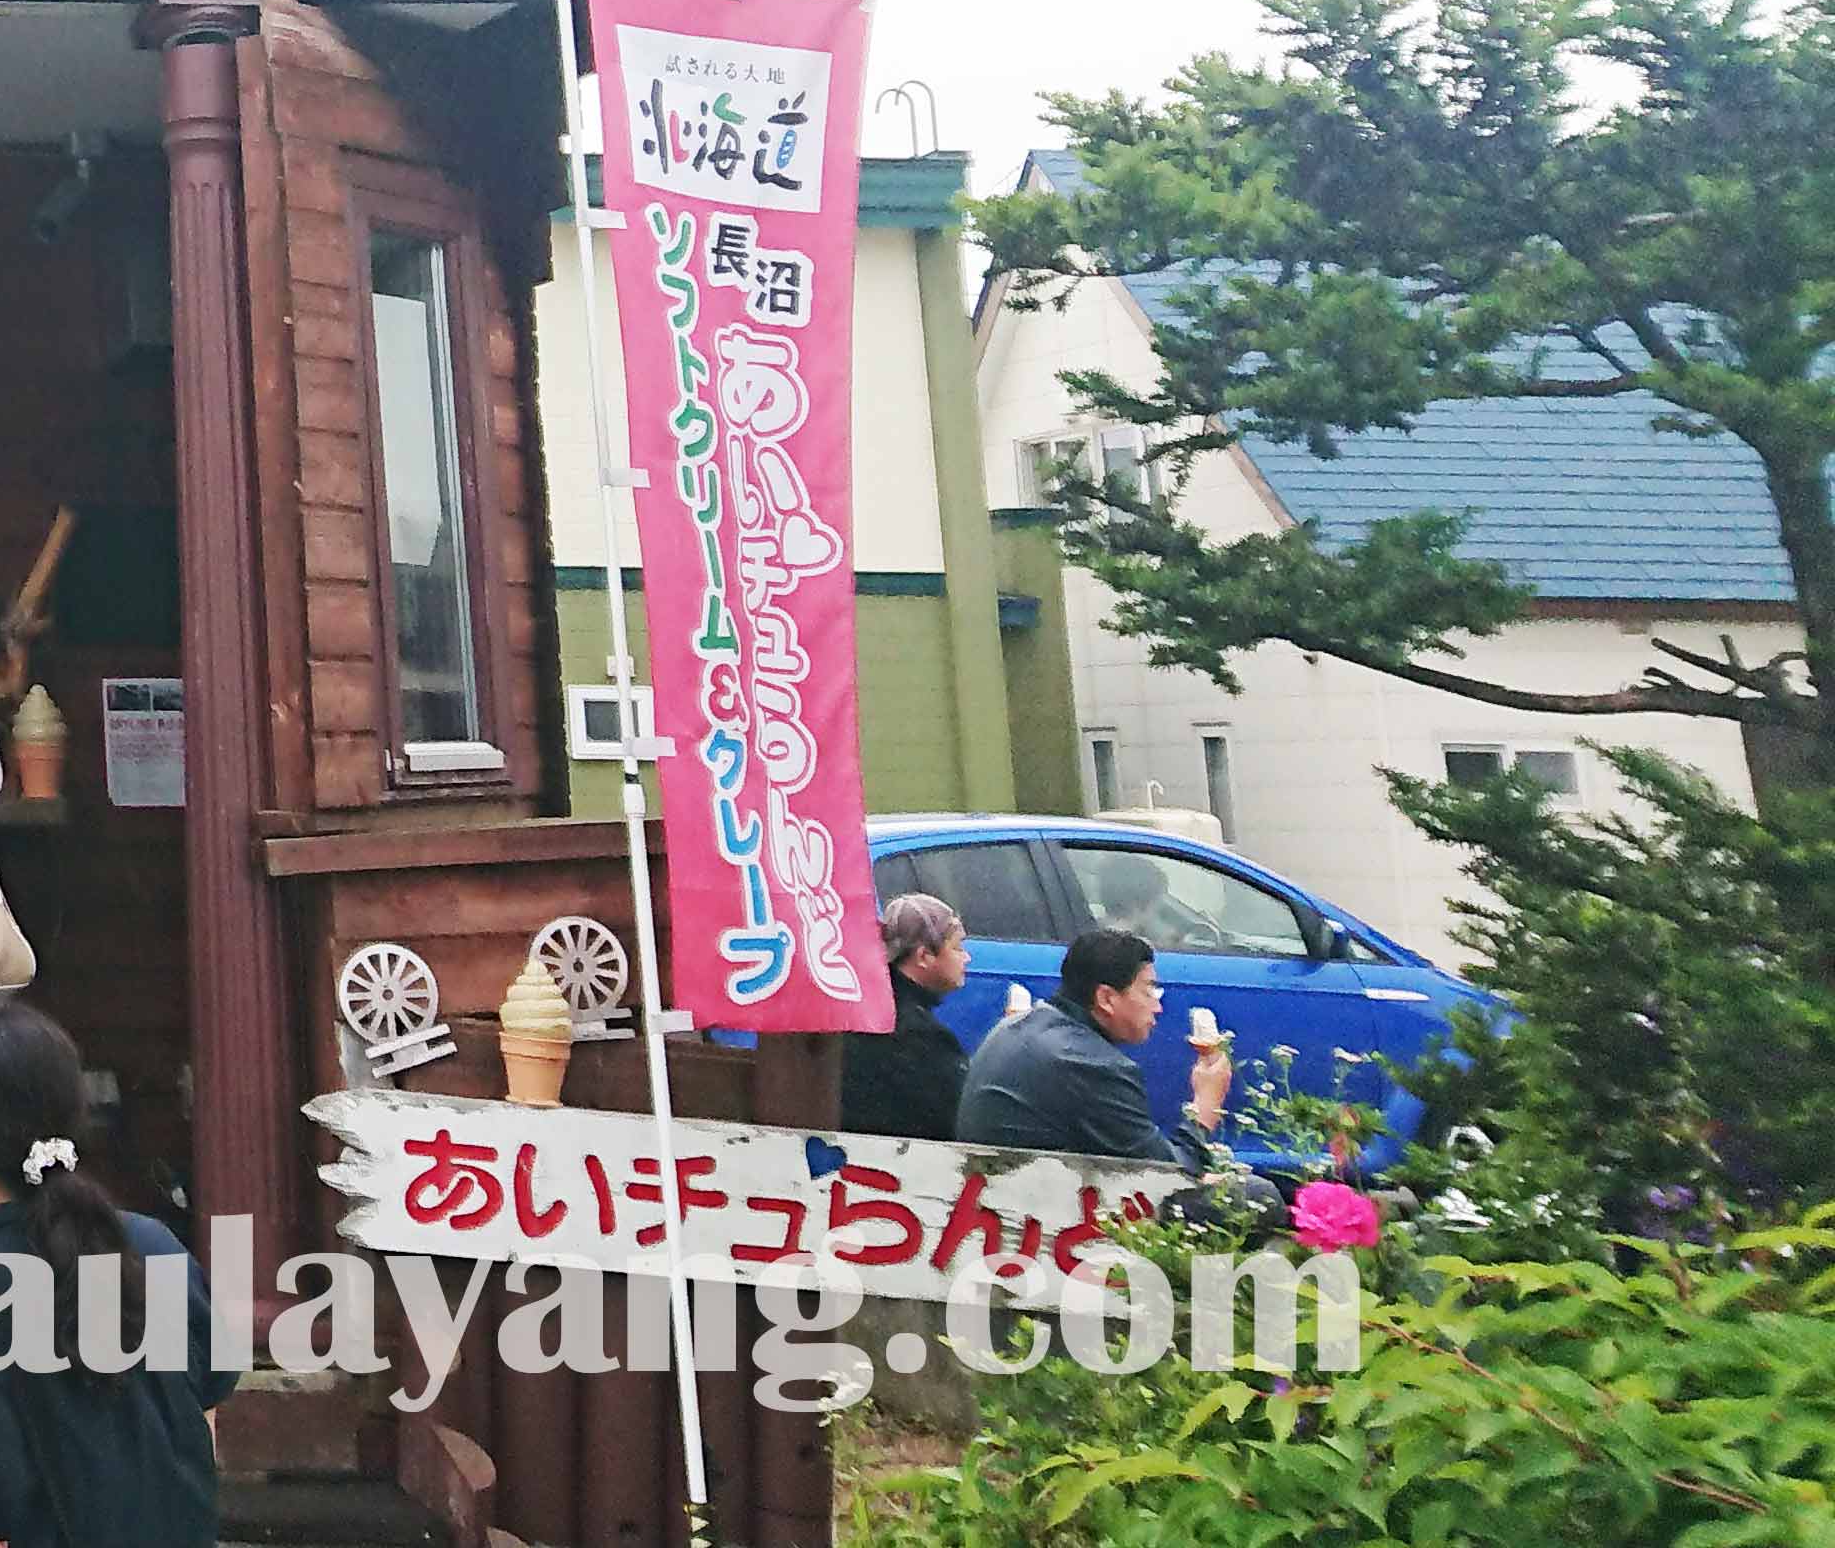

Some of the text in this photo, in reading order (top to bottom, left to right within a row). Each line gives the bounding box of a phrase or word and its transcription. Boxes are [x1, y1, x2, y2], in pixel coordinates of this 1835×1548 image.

[665, 55, 787, 85] 試される大地
[639, 78, 809, 192] 北海道
[711, 223, 802, 317] 長沼
